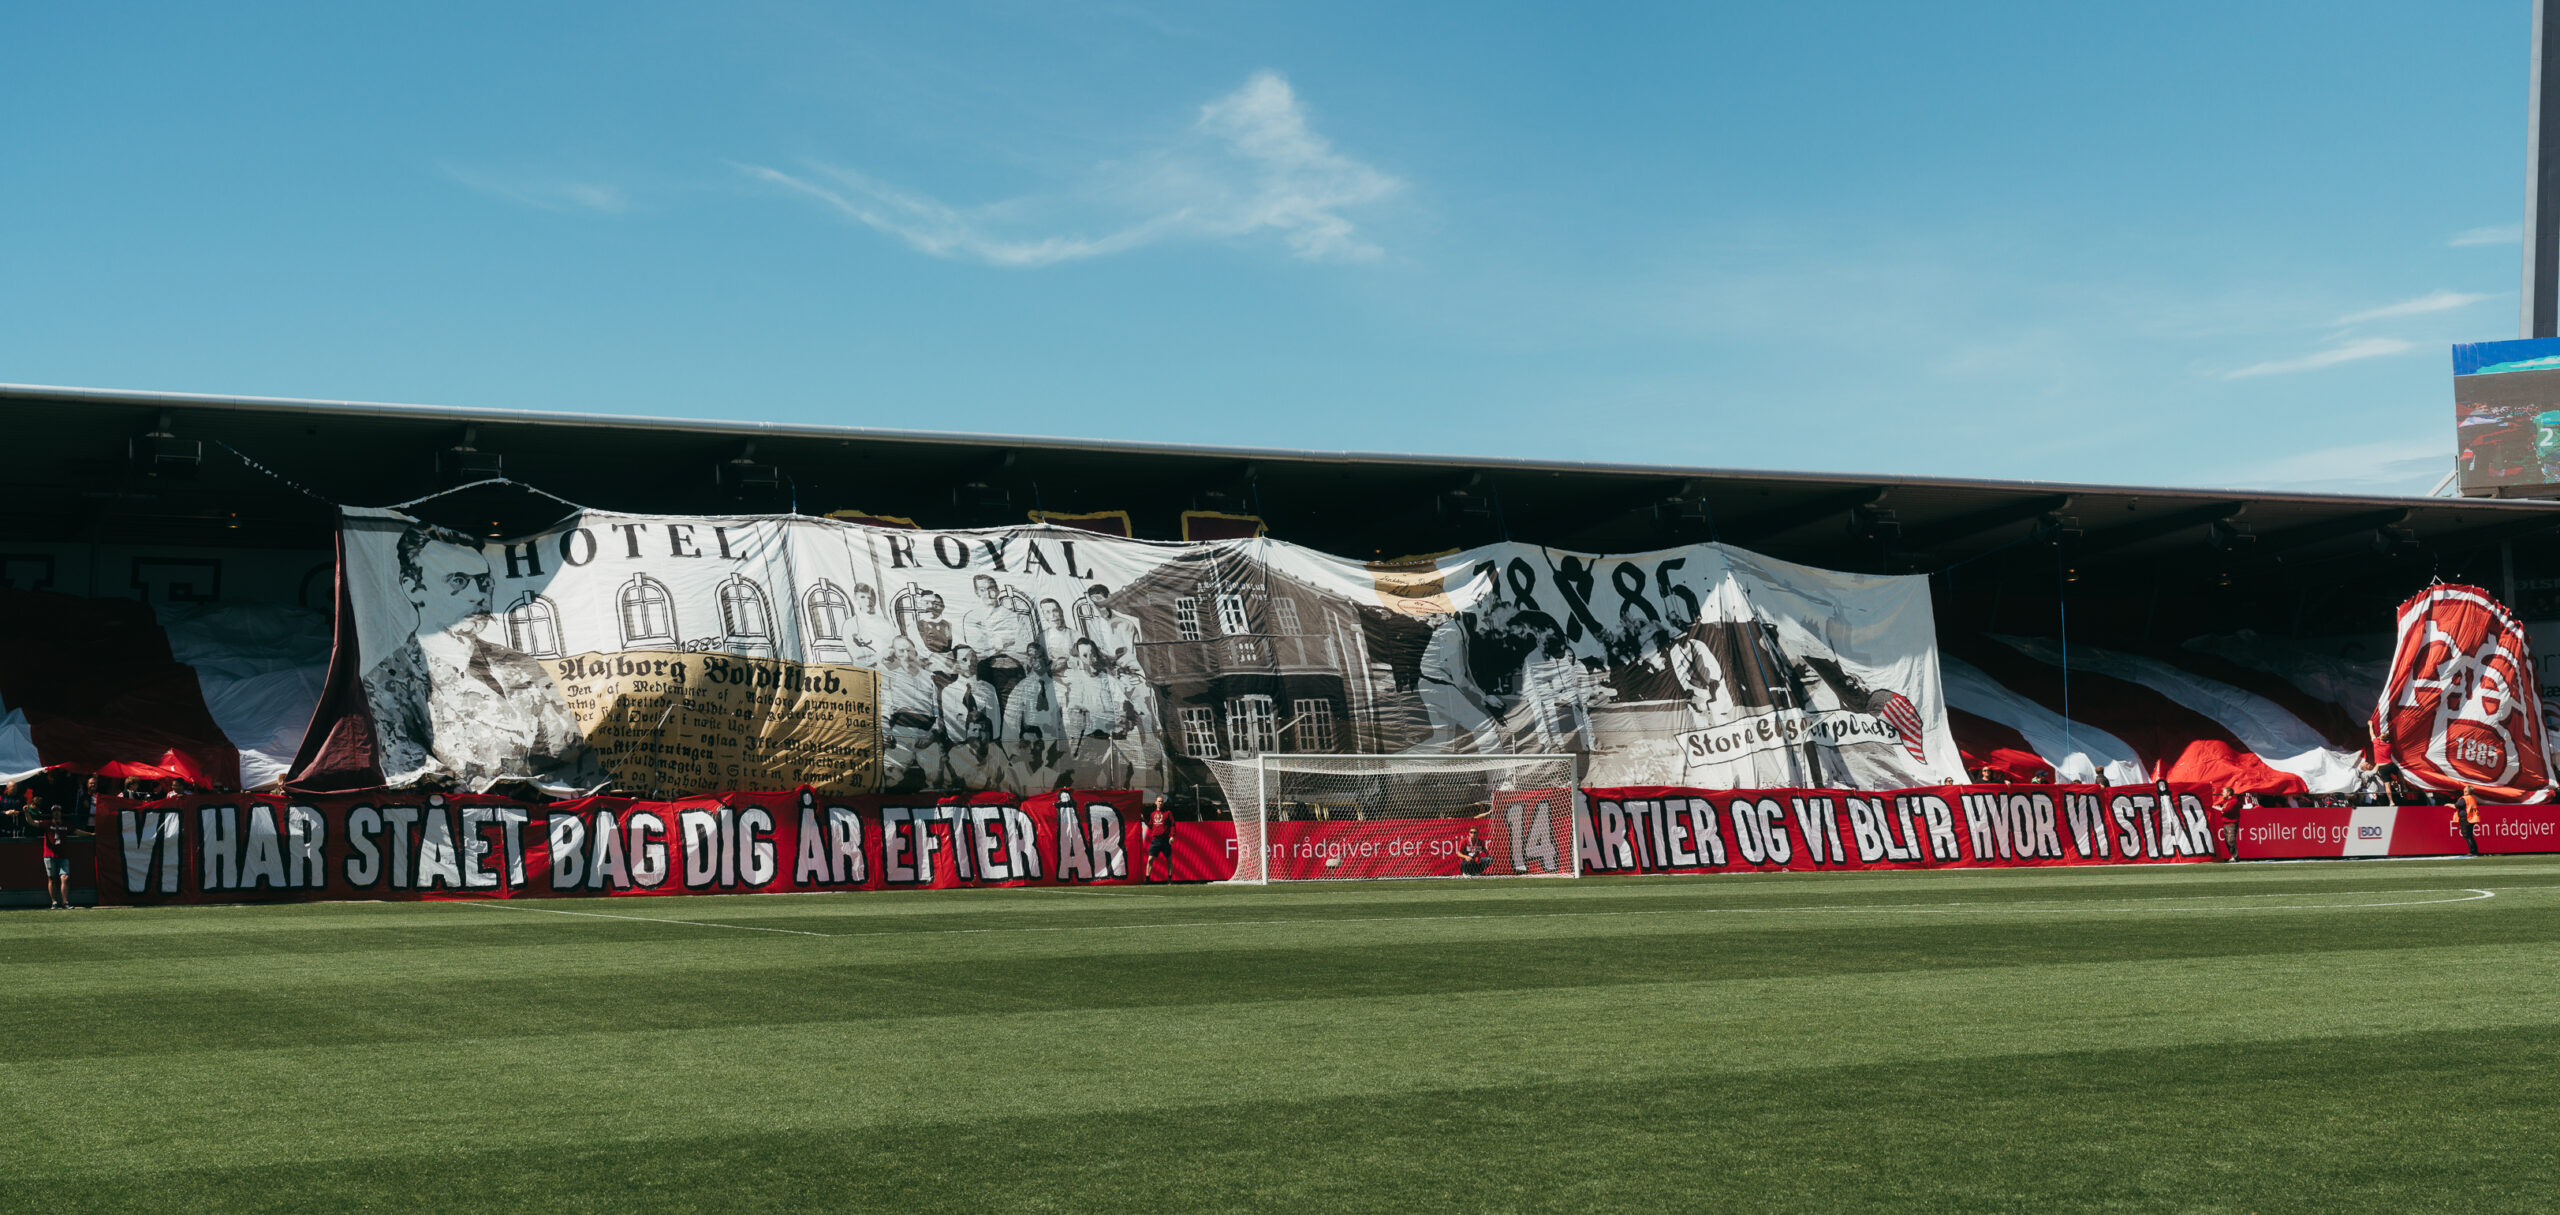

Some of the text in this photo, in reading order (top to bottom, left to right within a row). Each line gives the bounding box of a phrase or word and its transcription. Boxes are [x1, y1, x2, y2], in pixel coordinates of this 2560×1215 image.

[2540, 428, 2553, 446] 2
[505, 522, 1094, 580] HOTEL ROYAL
[680, 636, 722, 654] 1885
[567, 685, 592, 697] Den
[607, 682, 620, 694] af
[1688, 728, 1754, 757] Store
[2454, 737, 2499, 768] 1885
[1505, 799, 1560, 873] 14
[1732, 798, 1791, 868] OG
[1795, 794, 1846, 867] VI
[1846, 794, 1962, 863] BLI'R
[1960, 790, 2064, 861] HVOR
[2064, 792, 2110, 860] VI
[2112, 781, 2215, 859] STÅR
[2249, 823, 2297, 845] spiller
[2302, 822, 2326, 844] dig
[2359, 826, 2382, 838] BDO
[2473, 823, 2490, 837] en
[2496, 818, 2556, 840] rådgiver
[120, 786, 1127, 895] VI HAR STÅET BAG DIG ÅR EFTER ÅR
[1293, 836, 1380, 864] rådgiver
[1388, 836, 1423, 857] der
